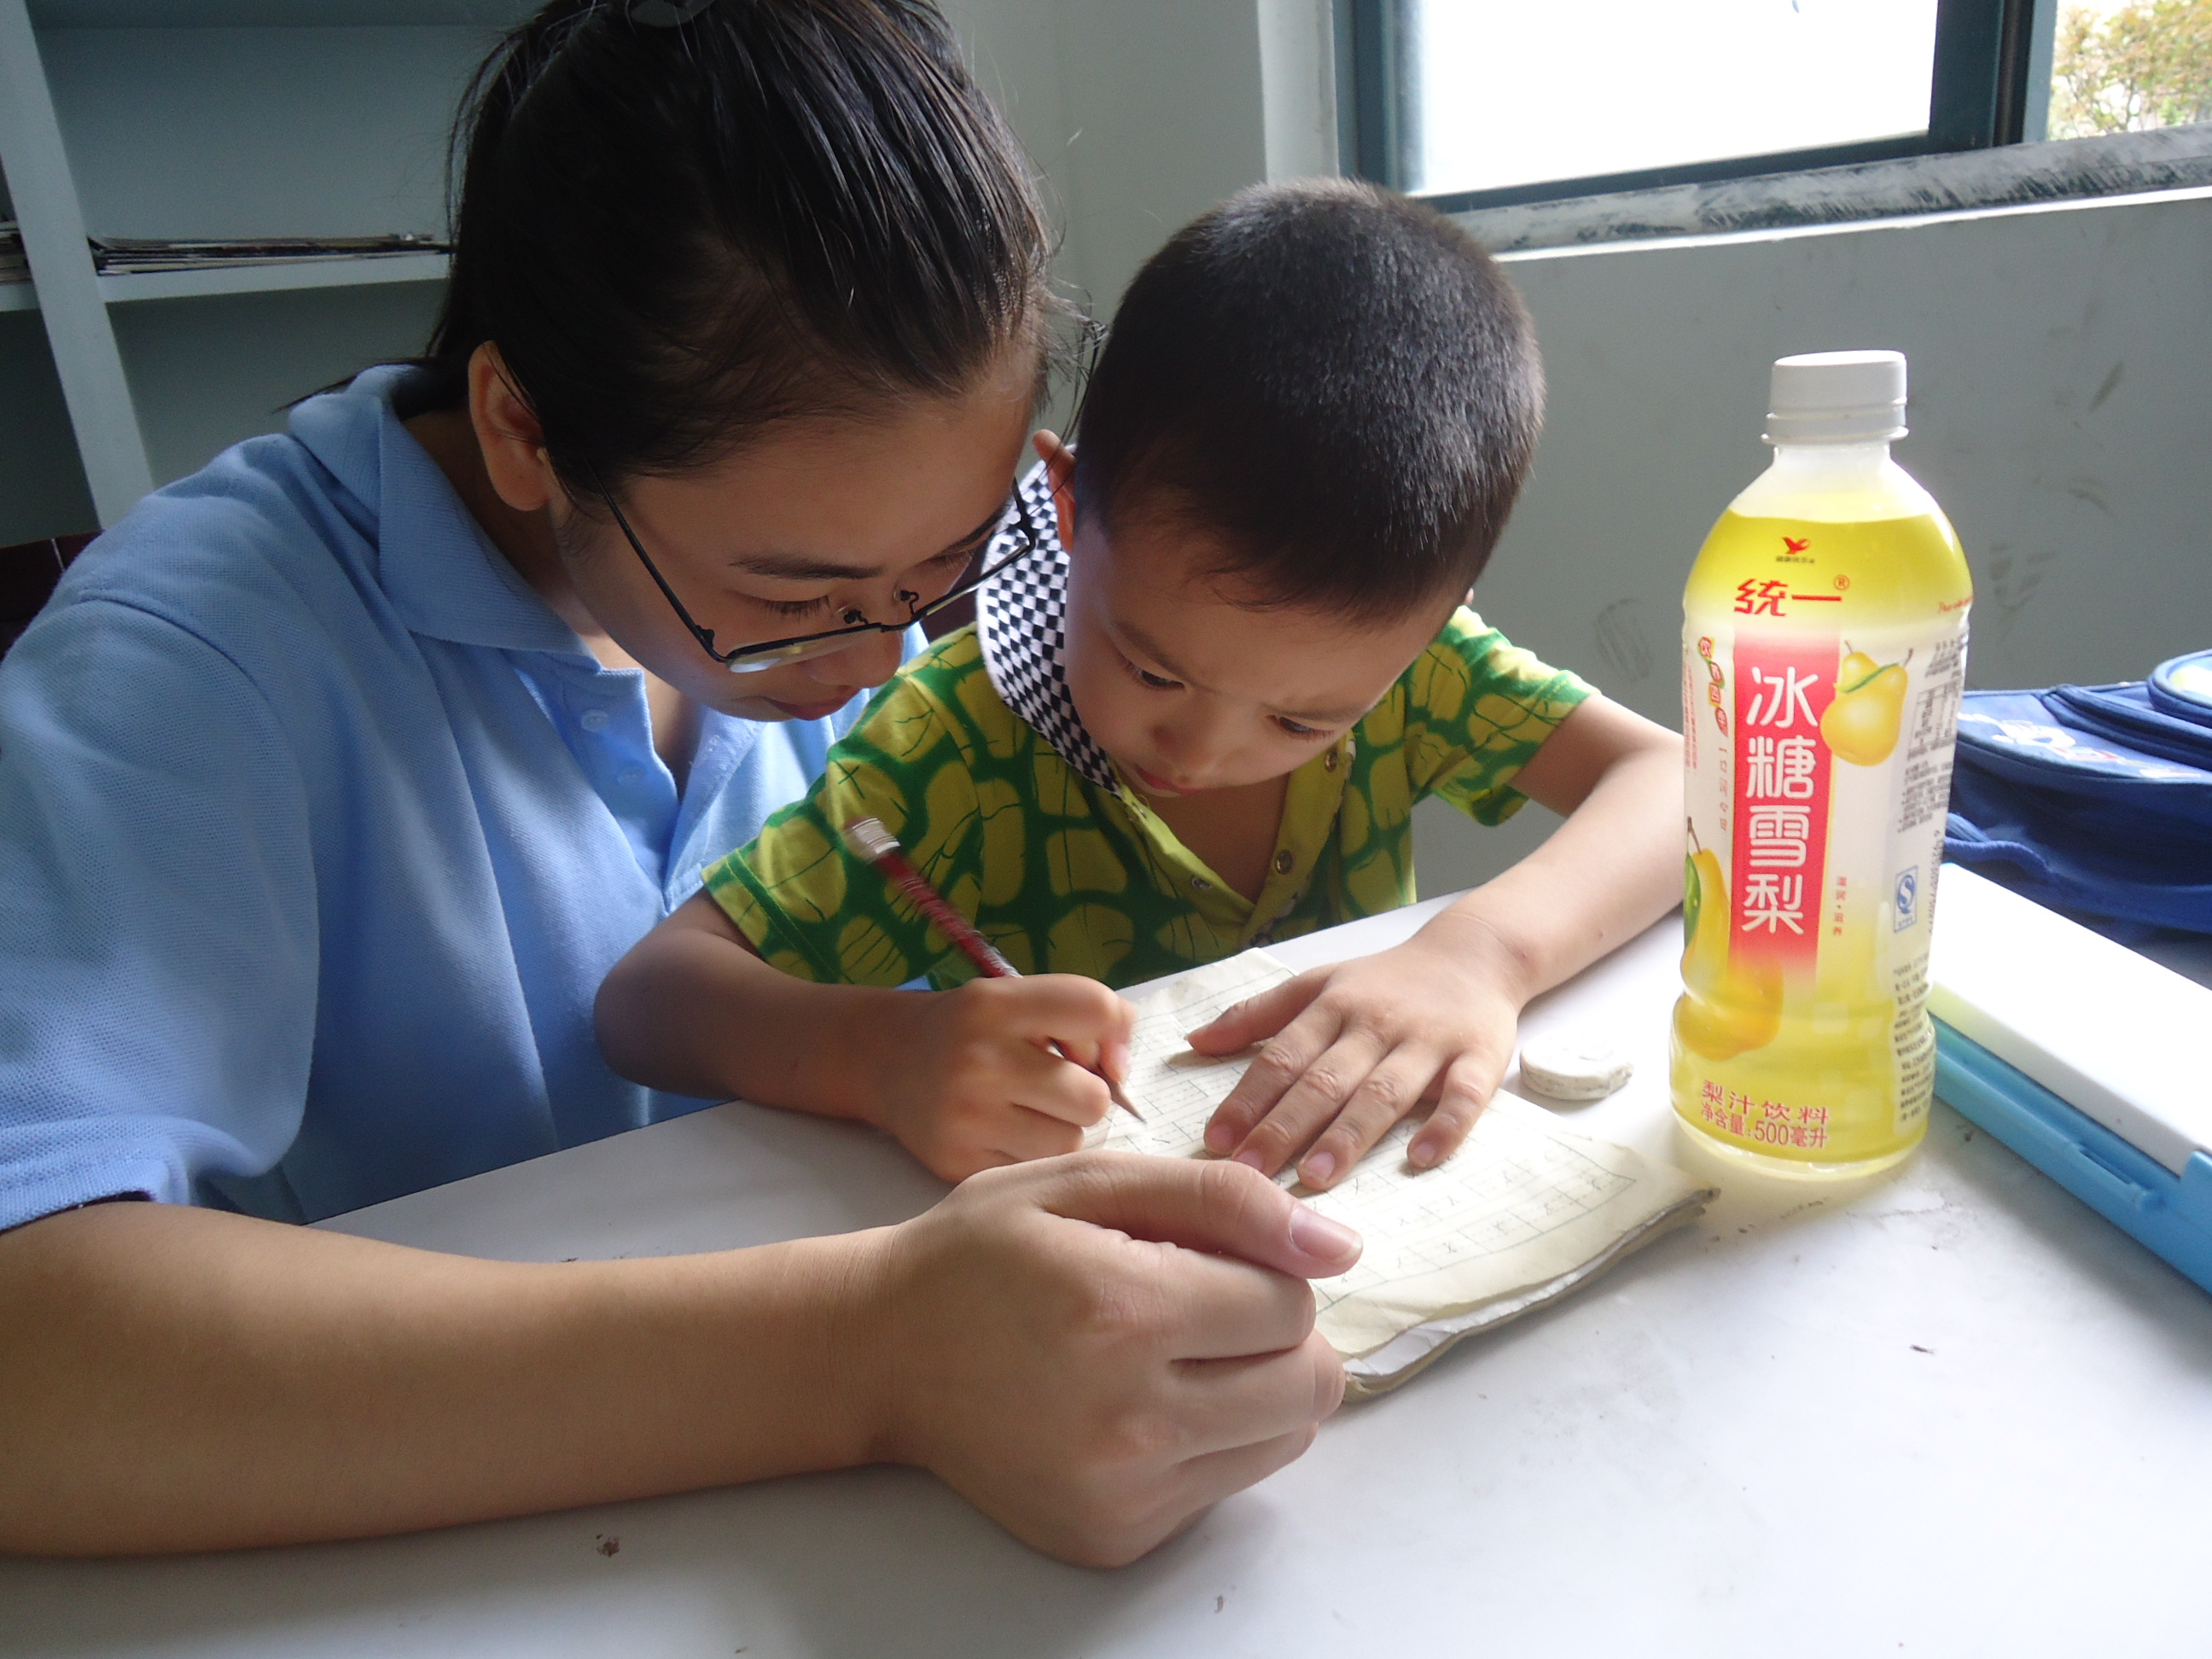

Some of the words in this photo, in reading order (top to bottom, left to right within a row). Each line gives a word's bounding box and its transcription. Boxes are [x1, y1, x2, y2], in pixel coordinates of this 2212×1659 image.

[1734, 578, 1842, 616] 统一
[1741, 666, 1819, 935] 冰糖雪梨
[1701, 1102, 1828, 1148] 净含量:500毫升
[1702, 1079, 1829, 1125] 梨汁饮料
